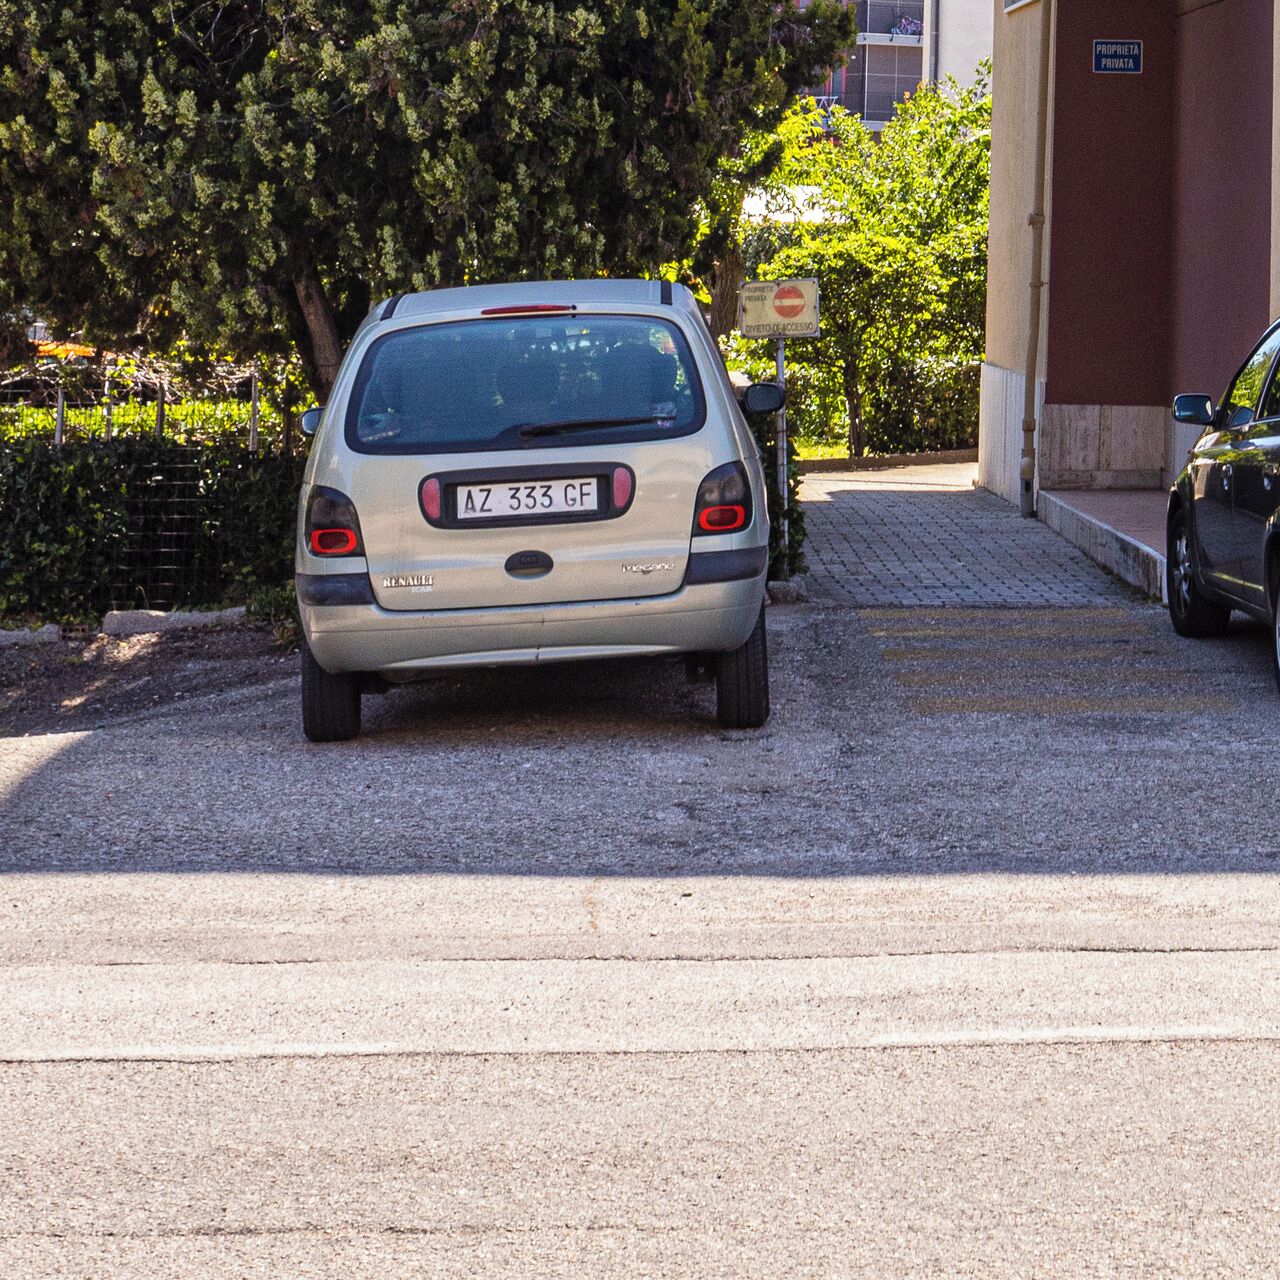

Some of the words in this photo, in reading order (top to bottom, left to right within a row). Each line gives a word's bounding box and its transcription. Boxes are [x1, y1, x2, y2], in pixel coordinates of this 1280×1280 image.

[1096, 43, 1139, 55] PROPRIETÀ
[1101, 58, 1134, 68] PRIVATA
[745, 323, 770, 333] DIVIETO
[773, 322, 779, 332] DI
[782, 321, 814, 332] ACCESSO
[463, 488, 493, 513] AZ
[508, 485, 554, 511] 333
[564, 482, 592, 507] GF
[383, 575, 434, 587] RENAULT
